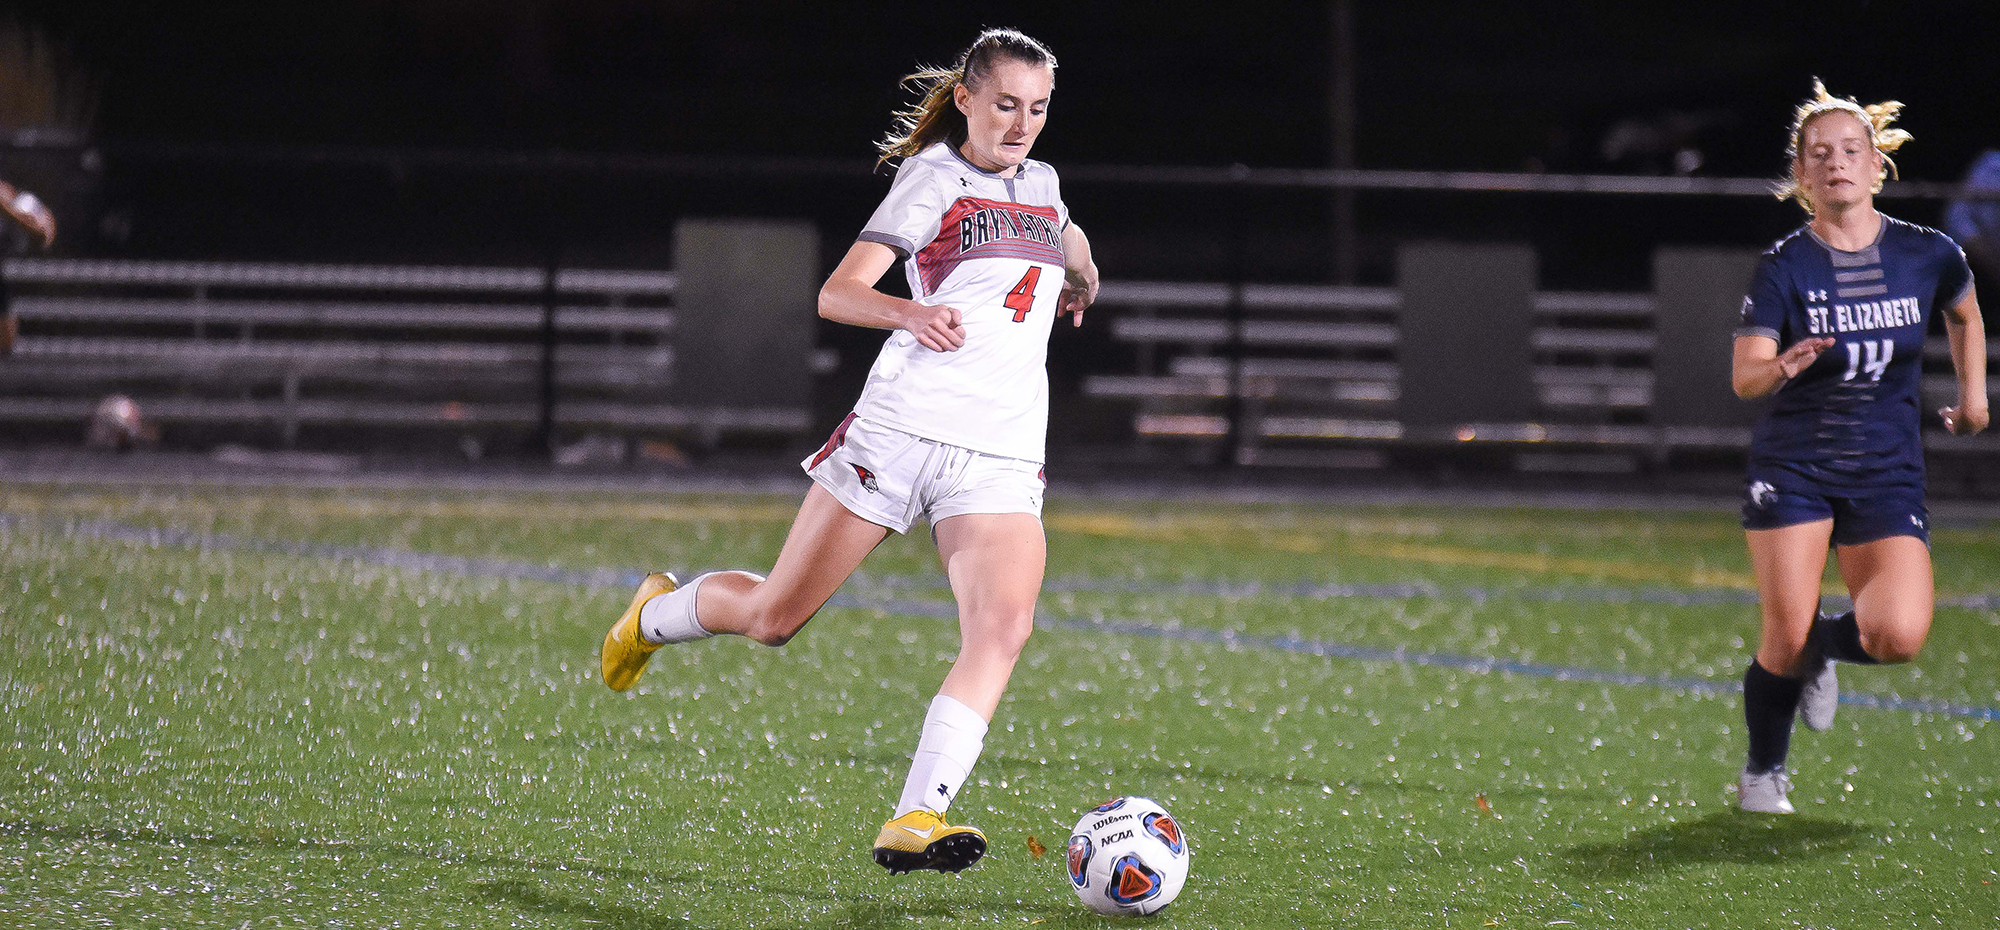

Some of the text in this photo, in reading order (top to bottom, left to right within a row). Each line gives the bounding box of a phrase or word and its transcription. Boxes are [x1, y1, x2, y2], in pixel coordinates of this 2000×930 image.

[959, 207, 1062, 255] BRYN ATH
[1003, 265, 1042, 323] 4
[1807, 298, 1920, 334] ST. ELIZABETH
[1843, 338, 1895, 382] 14
[1093, 814, 1133, 831] Wilson
[1101, 829, 1134, 848] NCAA
